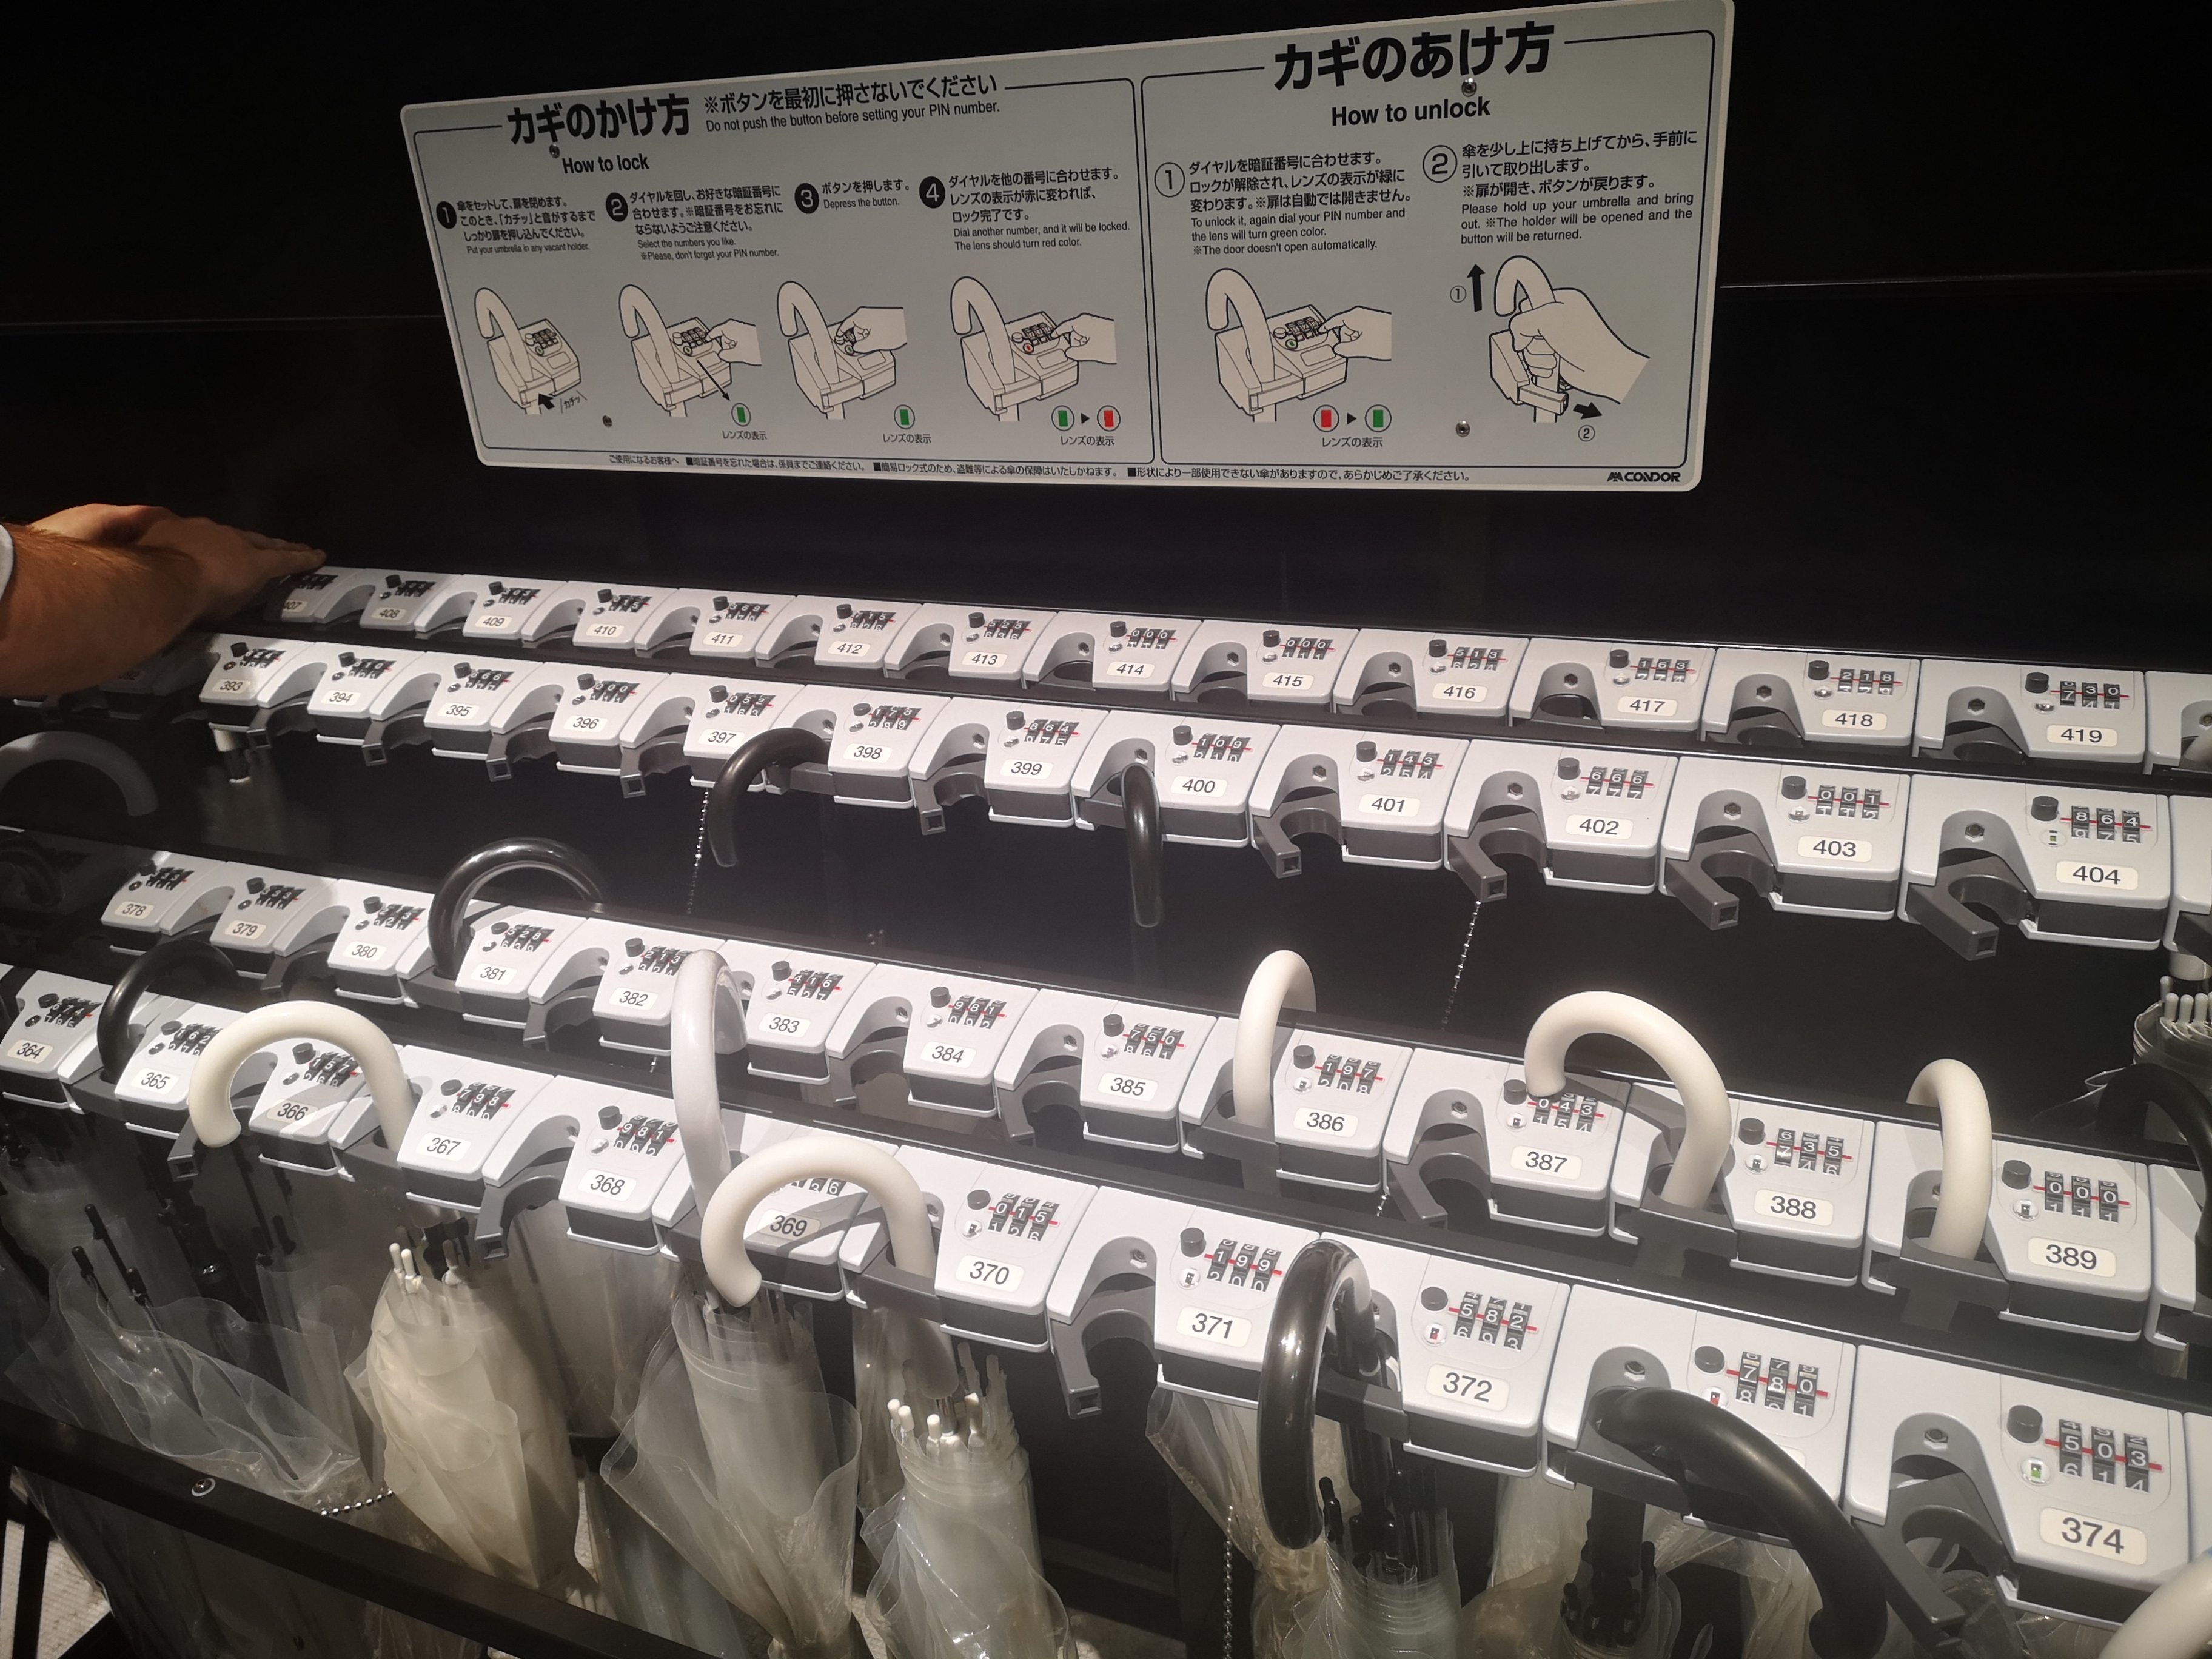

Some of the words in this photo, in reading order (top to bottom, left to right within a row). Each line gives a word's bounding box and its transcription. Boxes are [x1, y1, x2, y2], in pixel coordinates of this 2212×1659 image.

[1274, 20, 1555, 91] カギのあけ方
[705, 119, 721, 132] Do
[723, 118, 740, 131] not
[742, 116, 768, 132] push
[769, 115, 787, 127] the
[789, 113, 822, 126] button
[825, 110, 859, 124] before
[862, 107, 898, 122] setting
[900, 107, 925, 122] your
[929, 102, 950, 116] PIN
[953, 100, 1000, 115] number.
[1332, 106, 1379, 126] How
[1385, 104, 1407, 122] to
[1415, 95, 1490, 121] unlock
[506, 92, 689, 145] カギのかけ方
[561, 157, 594, 174] How
[597, 156, 614, 172] to
[616, 153, 650, 171] lock
[823, 199, 856, 210] Depress
[857, 198, 871, 207] the
[872, 197, 900, 206] button.
[1461, 204, 1498, 214] Please
[1504, 201, 1527, 212] hold
[1533, 202, 1546, 213] up
[1552, 200, 1577, 212] your
[1583, 195, 1631, 209] umbrella
[1637, 193, 1658, 206] and
[1664, 192, 1694, 206] bring
[1190, 217, 1202, 227] To
[1205, 215, 1236, 227] unlock
[1249, 213, 1276, 227] again
[1278, 212, 1296, 224] dial
[1298, 213, 1320, 225] your
[1323, 210, 1341, 221] PIN
[1344, 209, 1383, 220] number
[1386, 207, 1405, 218] and
[1461, 218, 1480, 230] out.
[1522, 215, 1557, 226] holder
[1560, 213, 1578, 224] will
[1582, 213, 1597, 224] be
[1601, 210, 1643, 224] opened
[1647, 208, 1670, 220] and
[1674, 208, 1692, 219] the
[953, 227, 970, 237] Dial
[971, 227, 1004, 237] another
[1006, 225, 1041, 236] number,
[1042, 223, 1059, 234] and
[1061, 224, 1067, 233] it
[1068, 223, 1083, 233] will
[1085, 223, 1096, 232] be
[1099, 221, 1130, 232] locked.
[1191, 231, 1207, 241] the
[1208, 230, 1228, 241] lens
[1230, 229, 1246, 240] will
[1248, 229, 1267, 240] turn
[1270, 229, 1298, 241] green
[1300, 226, 1327, 237] color.
[954, 241, 971, 250] The
[973, 240, 991, 250] lens
[993, 239, 1021, 249] should
[1022, 239, 1040, 248] turn
[1042, 237, 1056, 247] red
[1058, 236, 1081, 247] color.
[1461, 234, 1493, 244] button
[1496, 232, 1513, 243] will
[1517, 231, 1530, 242] be
[1533, 229, 1581, 241] returned.
[1223, 244, 1245, 254] door
[1247, 242, 1282, 253] doesn't
[1284, 243, 1309, 254] open
[1310, 238, 1377, 251] automatically.
[675, 250, 693, 260] don't
[693, 250, 715, 261] forget
[716, 251, 732, 260] your
[733, 249, 748, 257] PIN
[749, 248, 779, 257] number.
[722, 431, 767, 440] レンズの表示
[883, 434, 931, 444] レンズの表示
[1061, 435, 1114, 446] レンズの表示
[1322, 437, 1382, 447] レンズの表示
[1624, 472, 1681, 482] CONDOR
[380, 609, 400, 618] 408
[483, 617, 504, 626] 409
[594, 626, 617, 635] 410
[712, 634, 734, 644] 411
[837, 643, 862, 654] 412
[972, 654, 997, 665] 413
[1117, 664, 1144, 675] 414
[220, 681, 243, 691] 393
[1273, 675, 1303, 686] 415
[329, 692, 353, 702] 394
[1444, 686, 1476, 699] 416
[446, 705, 471, 716] 395
[1630, 700, 1665, 712] 417
[573, 717, 599, 729] 396
[1835, 713, 1872, 726] 418
[708, 731, 736, 743] 397
[2061, 729, 2102, 743] 419
[854, 746, 882, 759] 398
[1011, 762, 1042, 775] 399
[1183, 779, 1215, 793] 400
[1372, 798, 1404, 812] 401
[1580, 819, 1619, 835] 402
[1813, 840, 1855, 857] 403
[2073, 866, 2120, 884] 404
[122, 904, 147, 916] 378
[233, 923, 258, 936] 379
[352, 945, 377, 958] 380
[480, 967, 506, 980] 381
[619, 991, 648, 1006] 382
[769, 1017, 800, 1033] 383
[17, 1043, 44, 1059] 364
[932, 1046, 964, 1063] 384
[141, 1072, 170, 1089] 365
[1111, 1078, 1145, 1096] 385
[277, 1103, 308, 1120] 366
[1307, 1113, 1344, 1131] 386
[427, 1138, 461, 1155] 367
[1526, 1151, 1567, 1172] 387
[591, 1175, 625, 1195] 368
[1771, 1196, 1816, 1219] 388
[770, 1216, 808, 1237] 369
[2046, 1244, 2096, 1269] 389
[970, 1261, 1009, 1284] 370
[1192, 1313, 1233, 1338] 371
[1443, 1372, 1492, 1402] 372
[2062, 1517, 2124, 1554] 374
